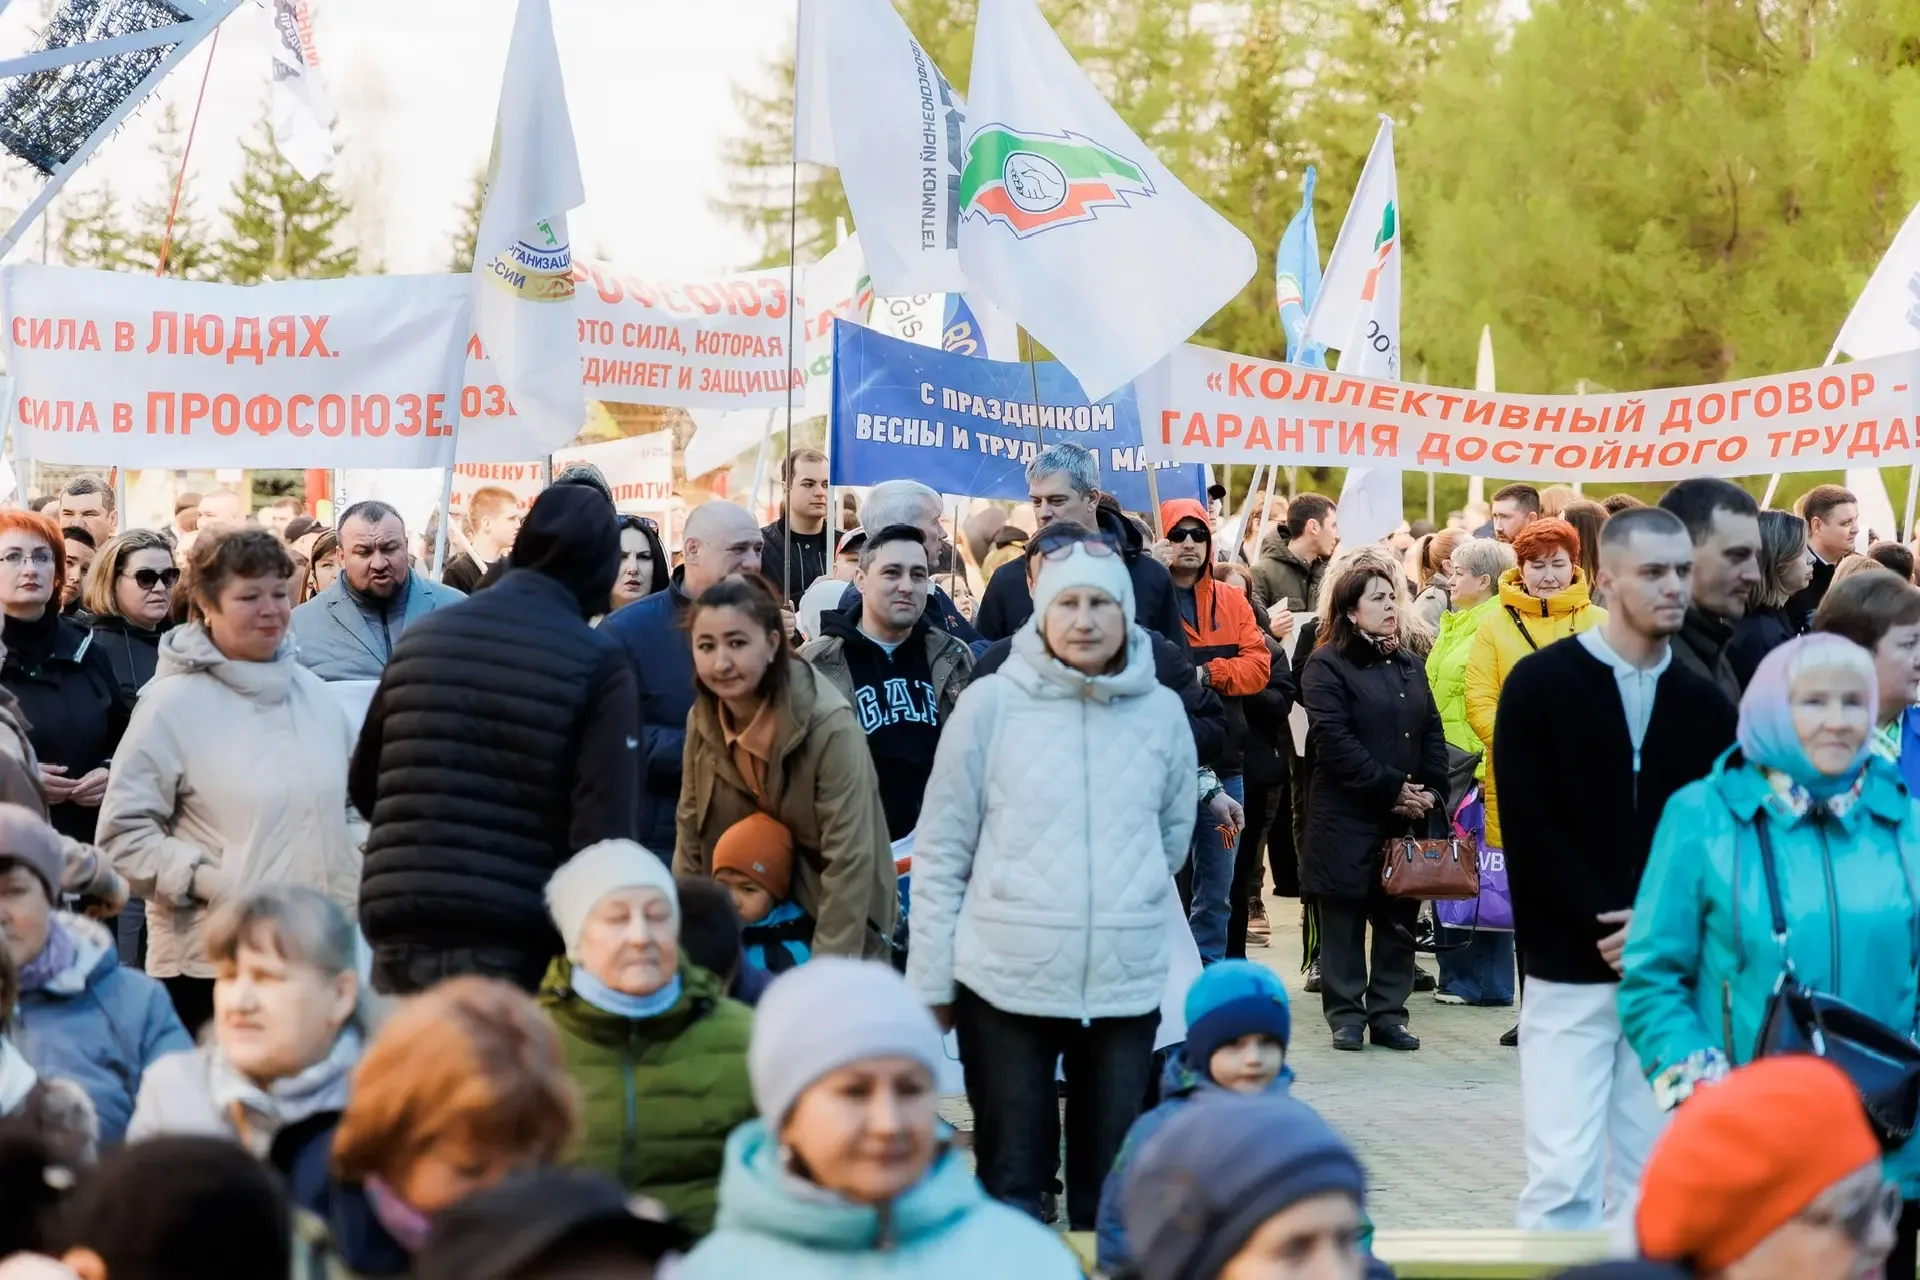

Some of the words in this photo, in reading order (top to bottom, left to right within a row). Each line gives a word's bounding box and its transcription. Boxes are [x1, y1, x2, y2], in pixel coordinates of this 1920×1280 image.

[12, 316, 101, 352] СИЛА
[146, 310, 340, 366] ЛЮДЯХ.
[622, 322, 687, 357] СИЛА,
[695, 330, 784, 358] КОТОРАЯ
[580, 357, 673, 388] ДИНЯЕТ
[678, 366, 692, 391] И
[1207, 363, 1646, 433] «КОЛЛЕКТИВНЫЙ
[1659, 372, 1875, 436] ДОГОВОР
[18, 396, 99, 433] СИЛА
[146, 391, 453, 437] ПРОФСОЮЗЕ.
[920, 381, 935, 405] С
[942, 387, 1115, 432] ПРАЗДНИКОМ
[855, 412, 944, 448] ВЕСНЫ
[952, 425, 969, 451] И
[976, 432, 1050, 465] ТРУД
[1161, 409, 1400, 458] ГАРАНТИЯ
[1416, 432, 1748, 469] ДОСТОЙНОГО
[1767, 414, 1920, 459] ТРУДА!
